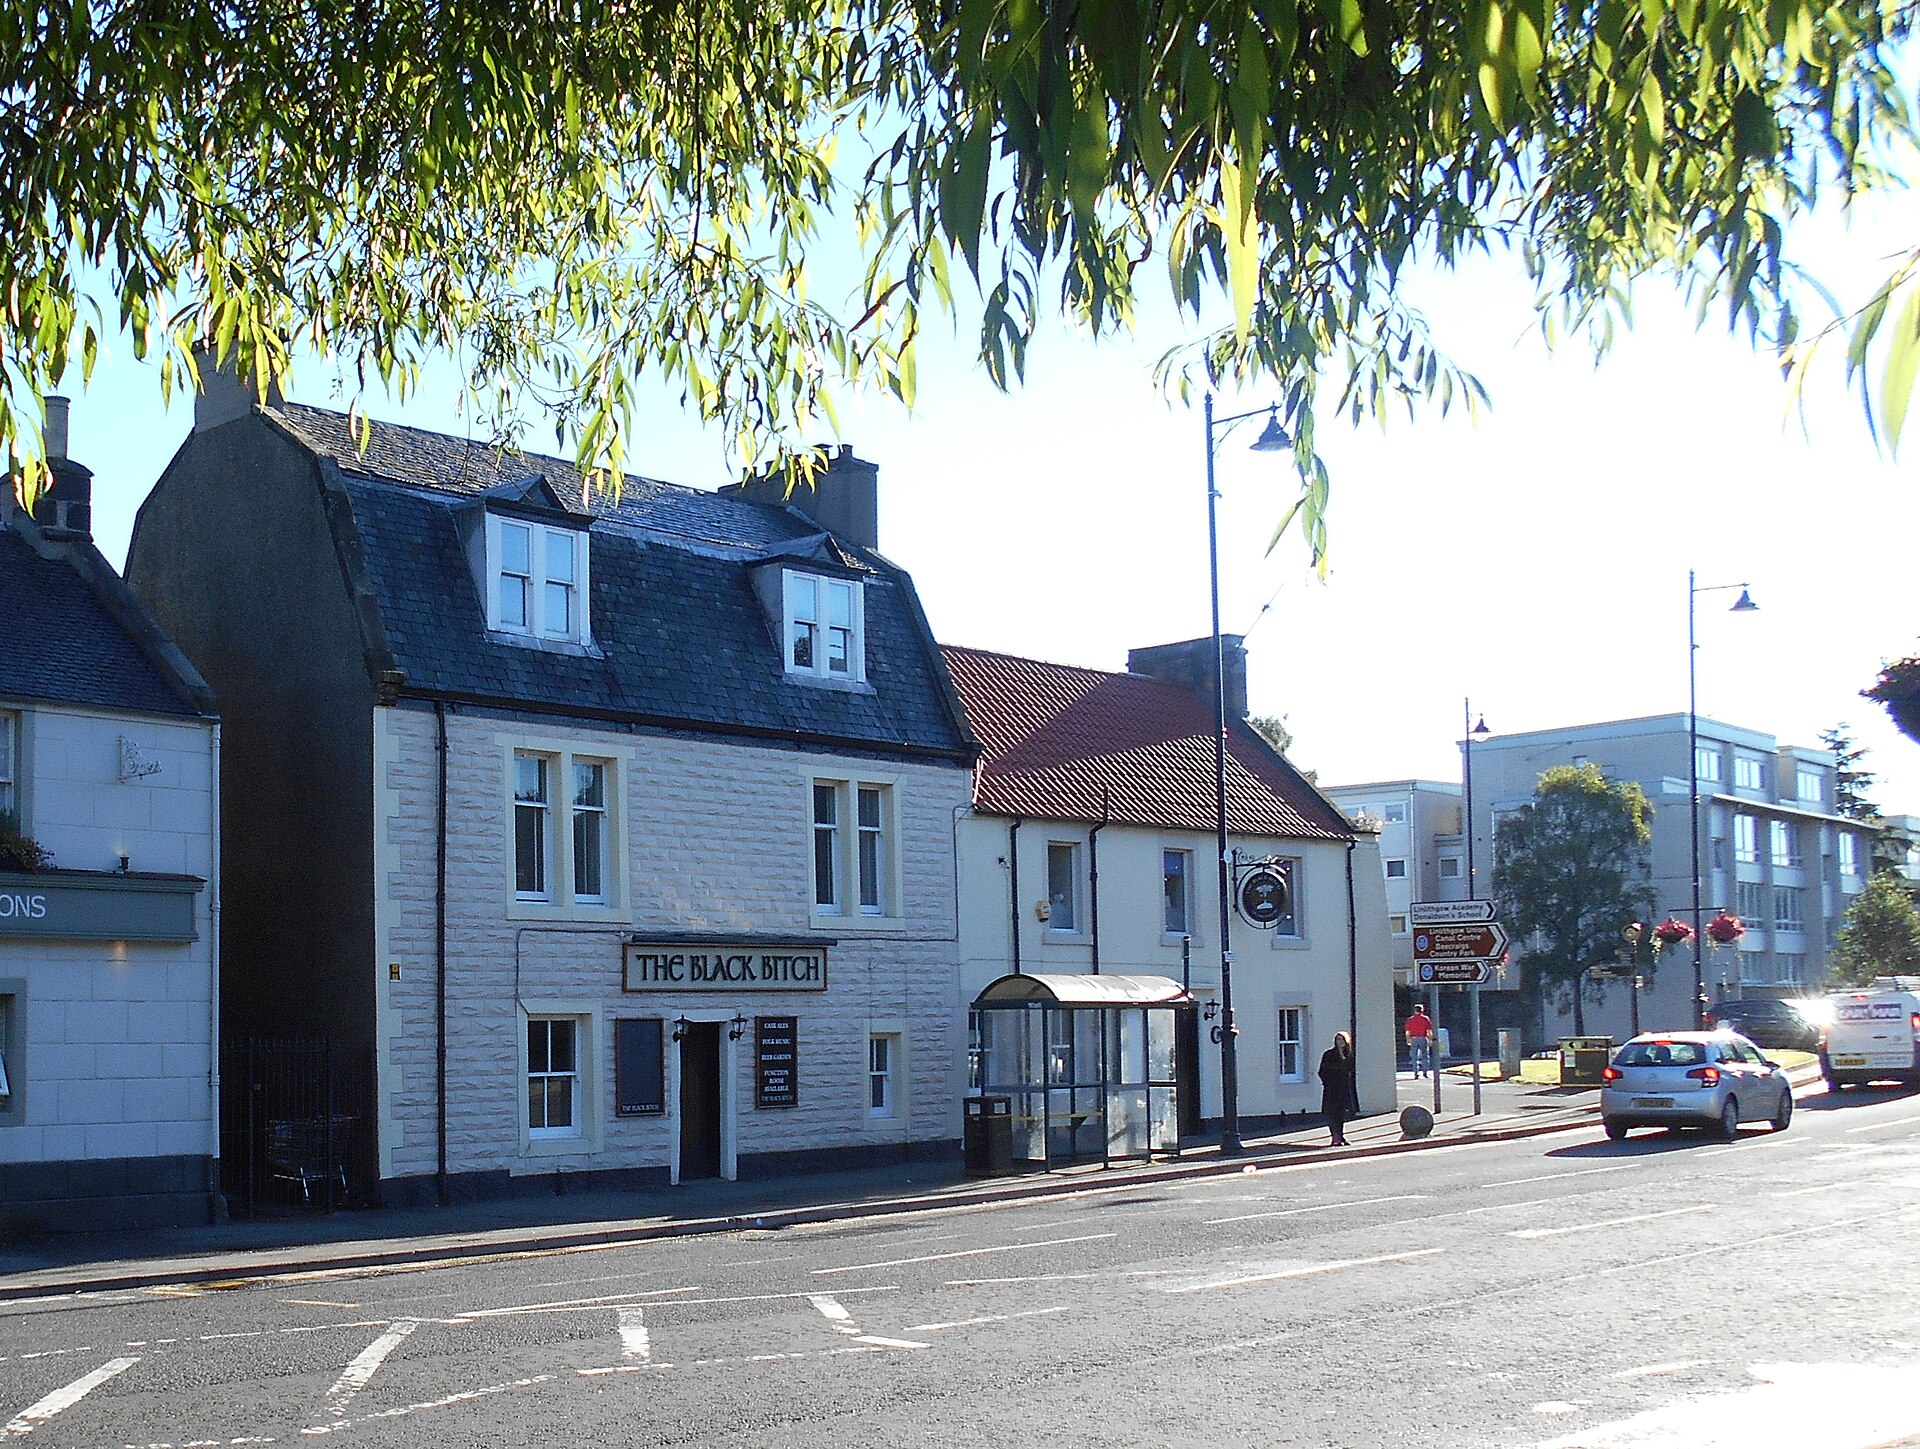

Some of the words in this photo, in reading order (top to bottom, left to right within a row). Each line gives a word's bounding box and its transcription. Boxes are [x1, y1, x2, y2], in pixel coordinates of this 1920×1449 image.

[0, 894, 46, 918] ONS
[1413, 905, 1449, 913] Linlithgow
[1429, 927, 1465, 935] Linlithgow
[1429, 950, 1457, 958] Country
[636, 954, 684, 982] THE
[690, 954, 757, 982] BLACK
[762, 955, 819, 981] BITCH
